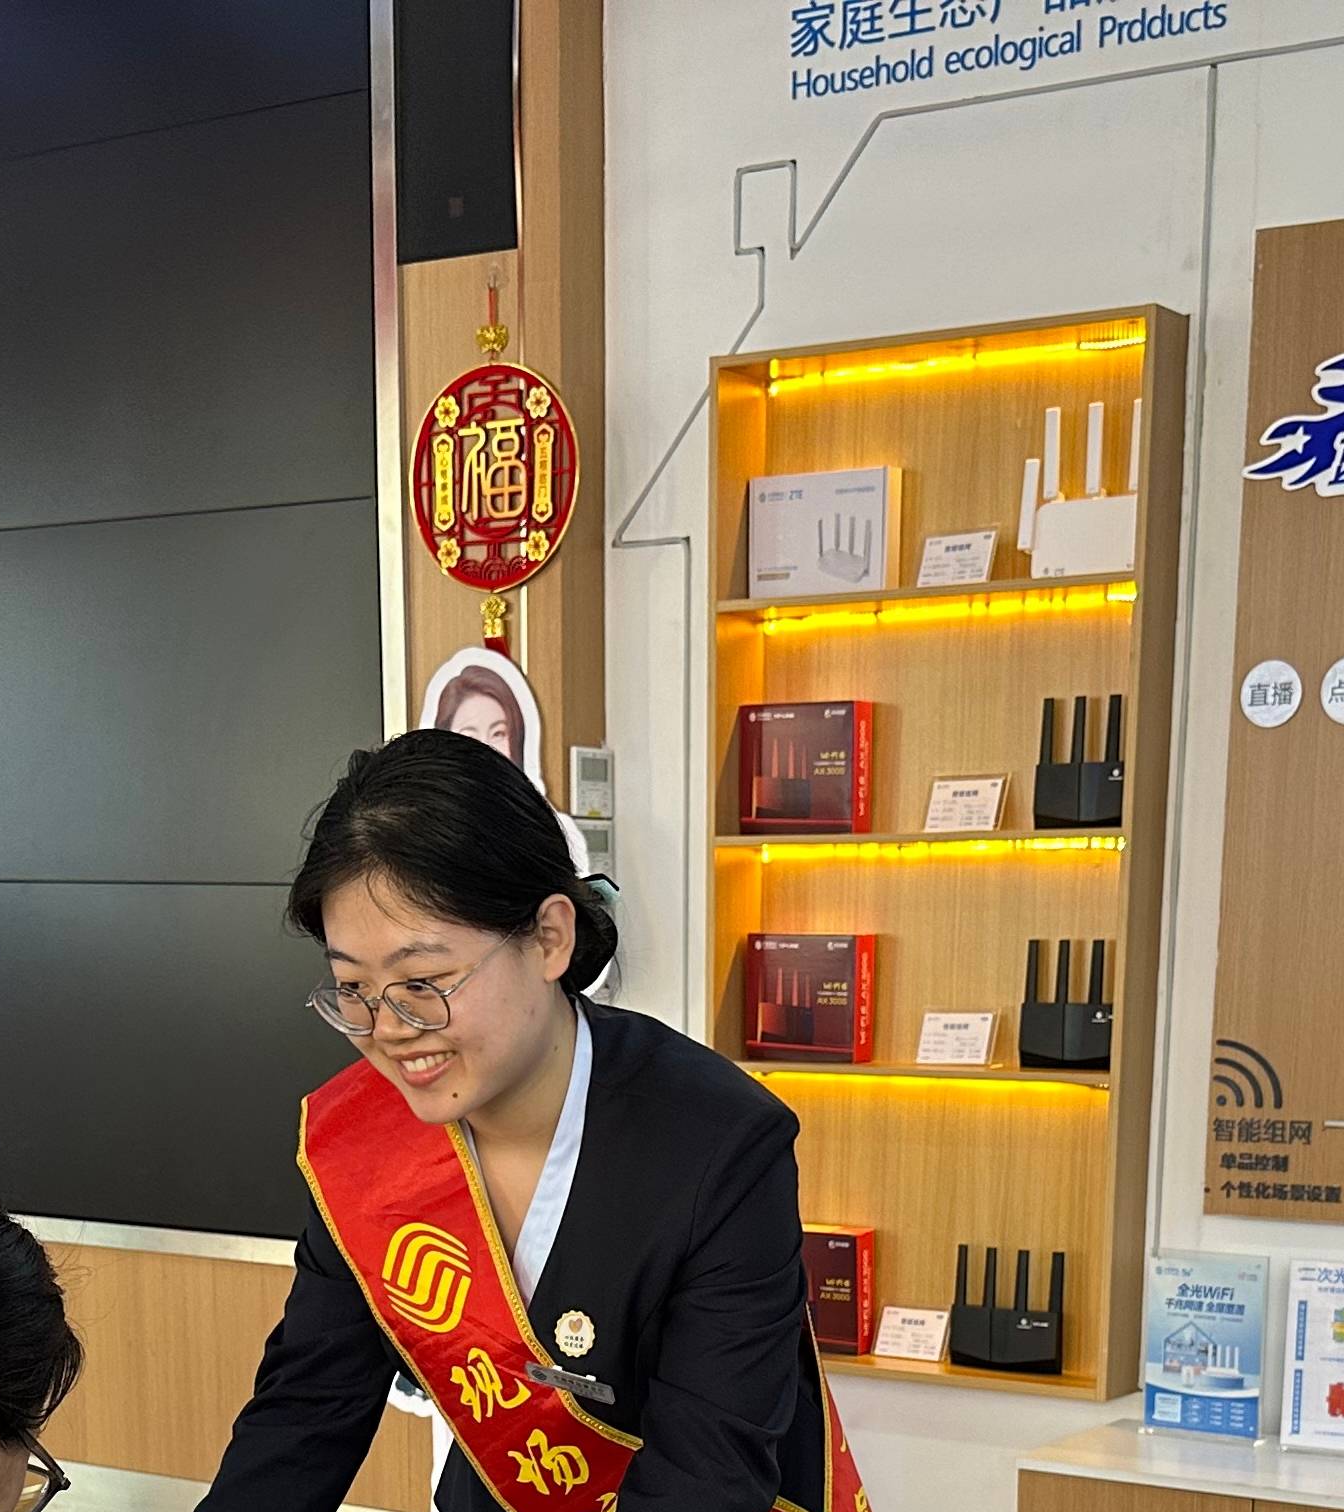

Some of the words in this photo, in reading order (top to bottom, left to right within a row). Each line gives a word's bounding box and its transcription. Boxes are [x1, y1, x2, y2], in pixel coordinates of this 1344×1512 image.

[790, 46, 933, 100] Household
[944, 20, 1082, 74] ecological
[1098, 1, 1227, 48] Prdducts
[457, 417, 527, 521] 福
[1247, 680, 1295, 709] 直播
[1212, 1116, 1313, 1146] 智能组网
[1219, 1152, 1290, 1173] 单品控制
[1176, 1282, 1235, 1300] 全光WiFi
